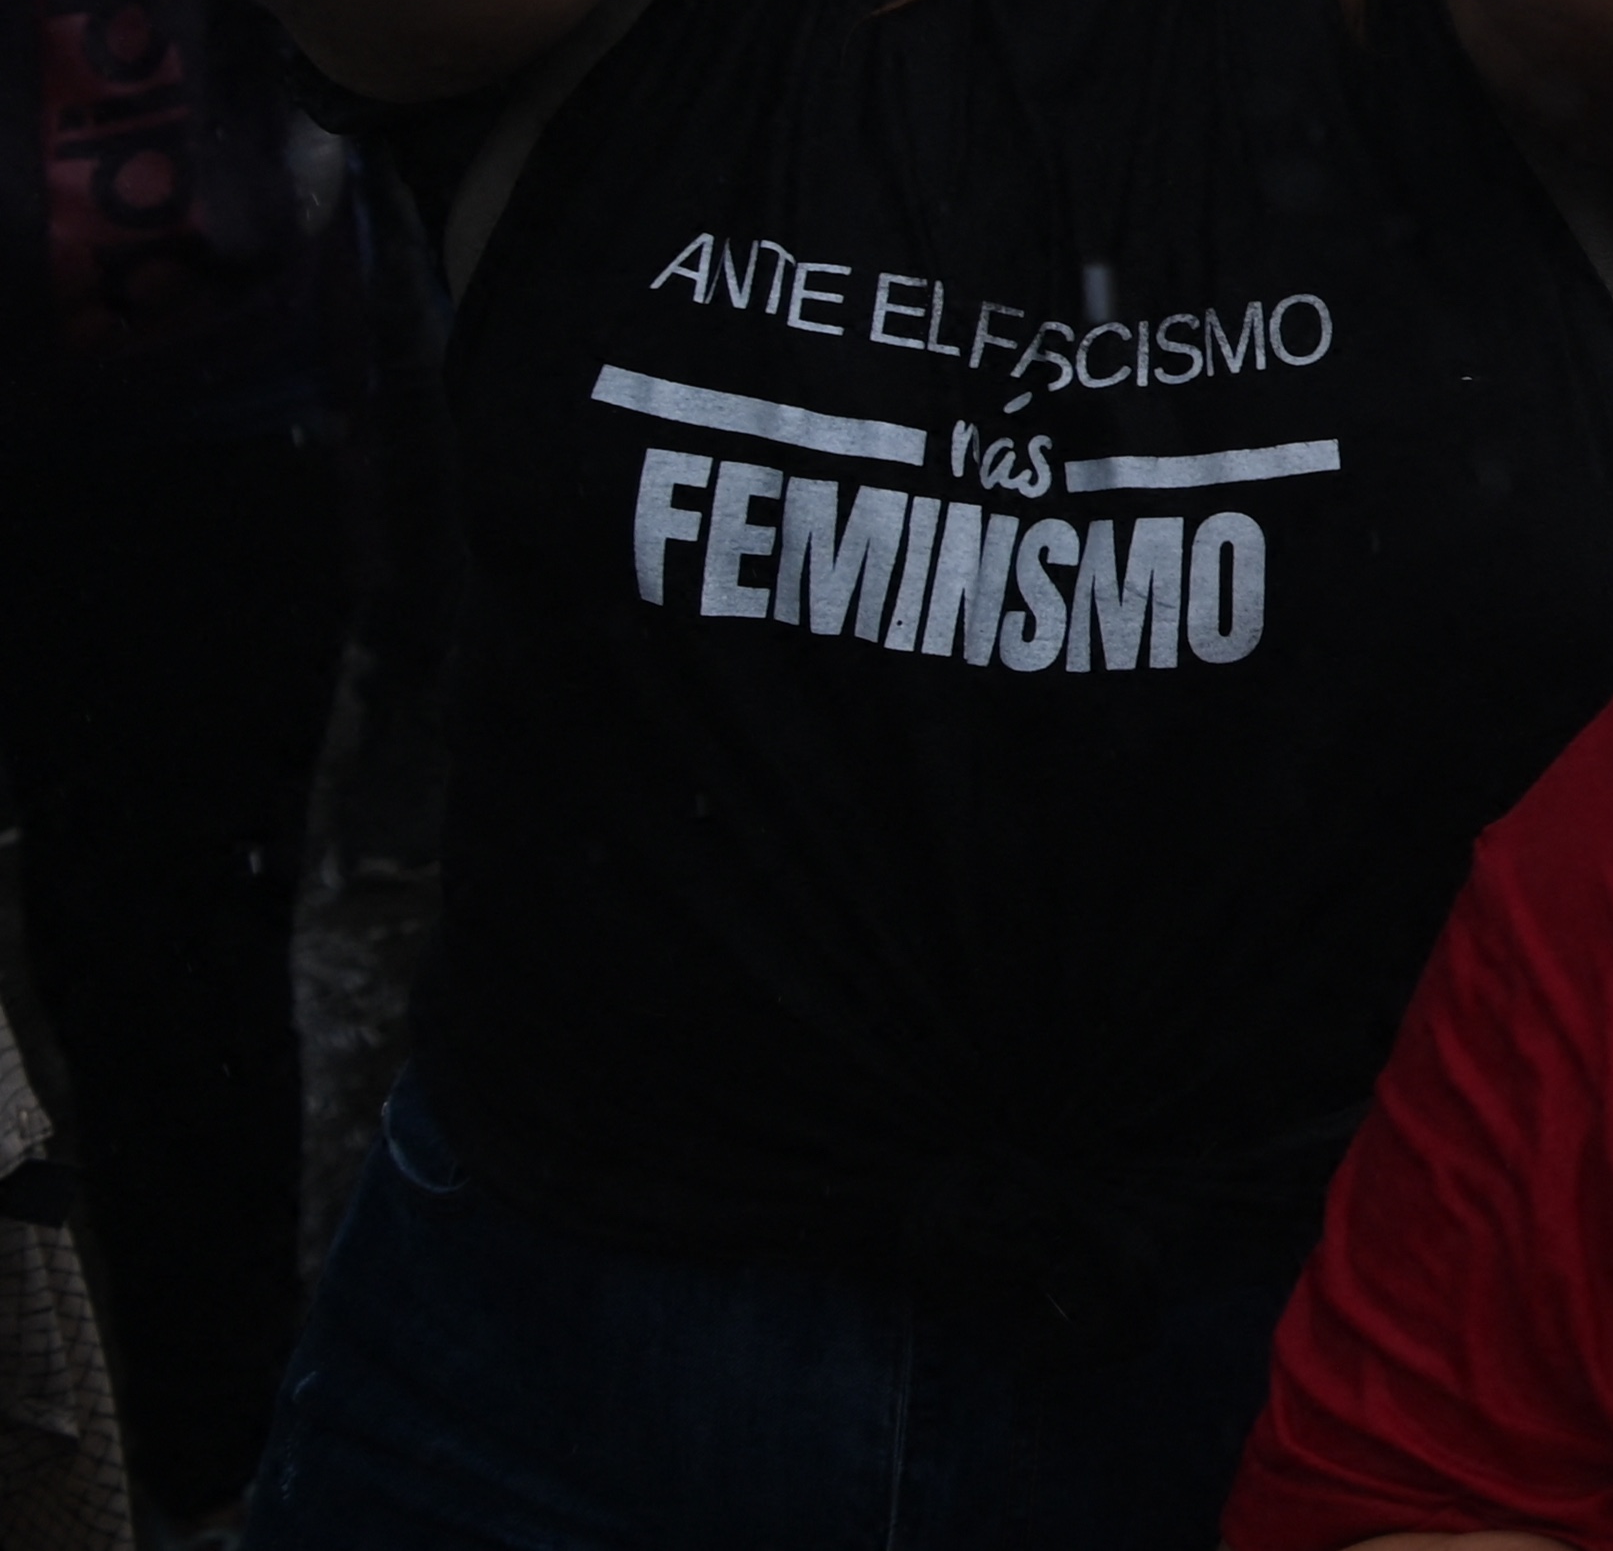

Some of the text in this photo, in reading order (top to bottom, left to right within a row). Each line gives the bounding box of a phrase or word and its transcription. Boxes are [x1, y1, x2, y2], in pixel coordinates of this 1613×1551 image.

[650, 232, 1333, 391] ANTE EL FASCISMO
